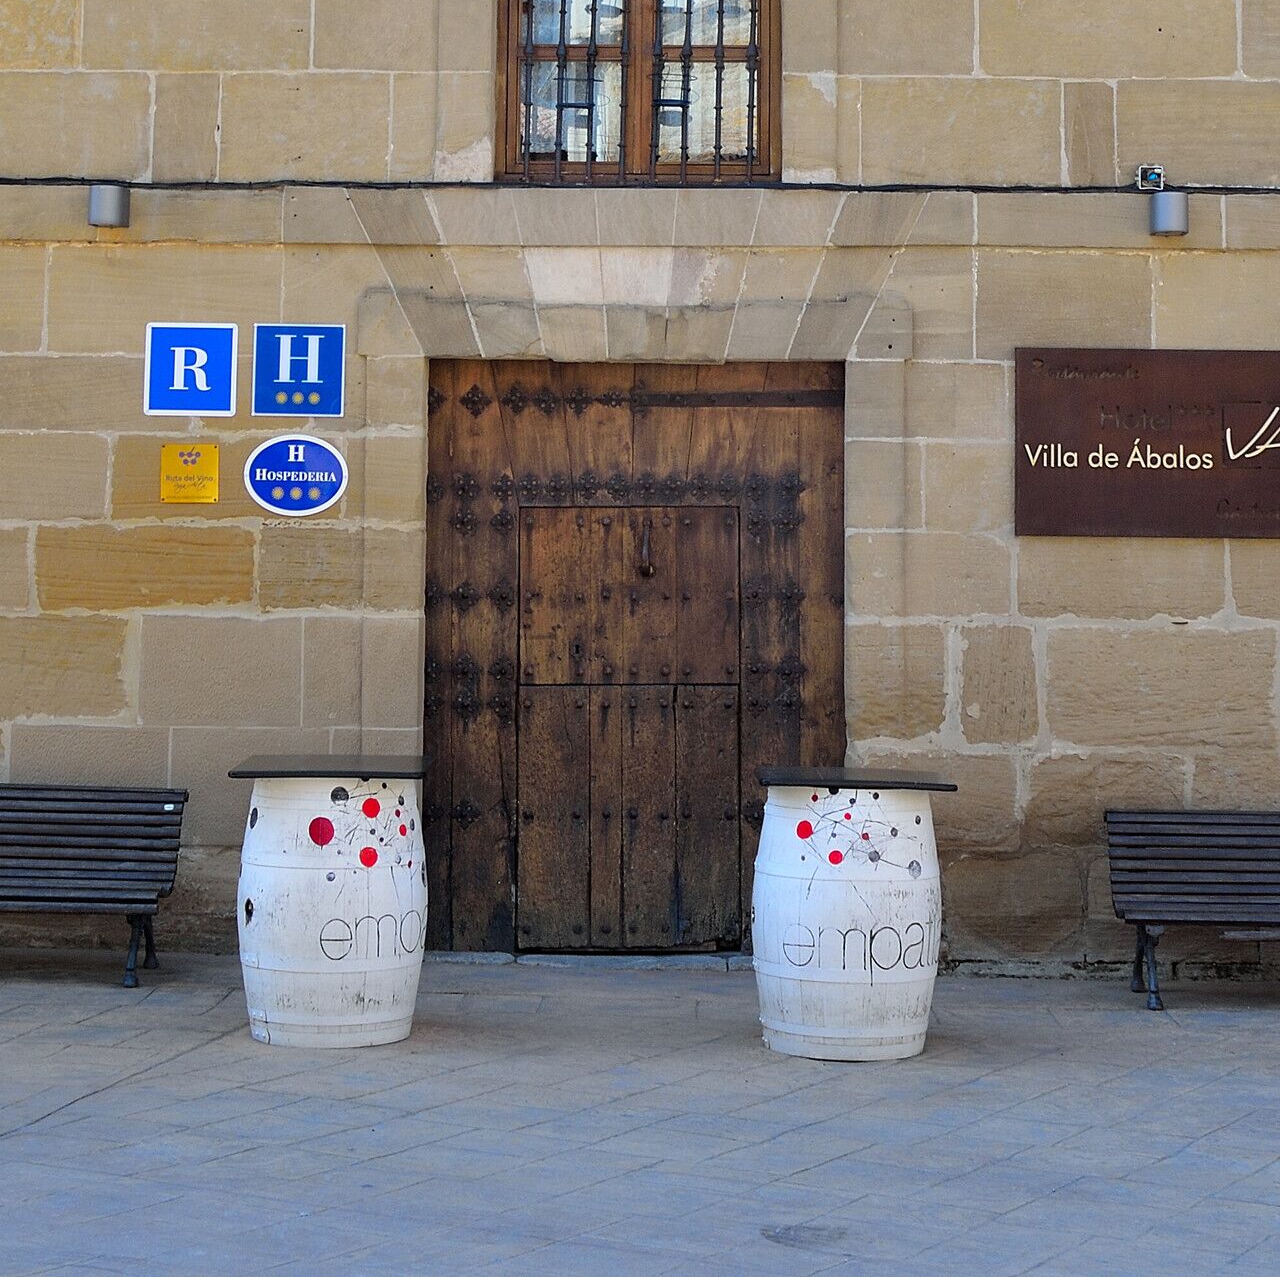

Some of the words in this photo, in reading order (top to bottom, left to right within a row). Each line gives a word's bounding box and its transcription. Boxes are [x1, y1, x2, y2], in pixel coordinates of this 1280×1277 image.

[168, 346, 212, 391] R
[273, 334, 325, 384] H
[287, 444, 306, 462] H
[1024, 443, 1078, 468] Villa
[1088, 444, 1119, 469] de
[1126, 438, 1214, 470] Ábalos
